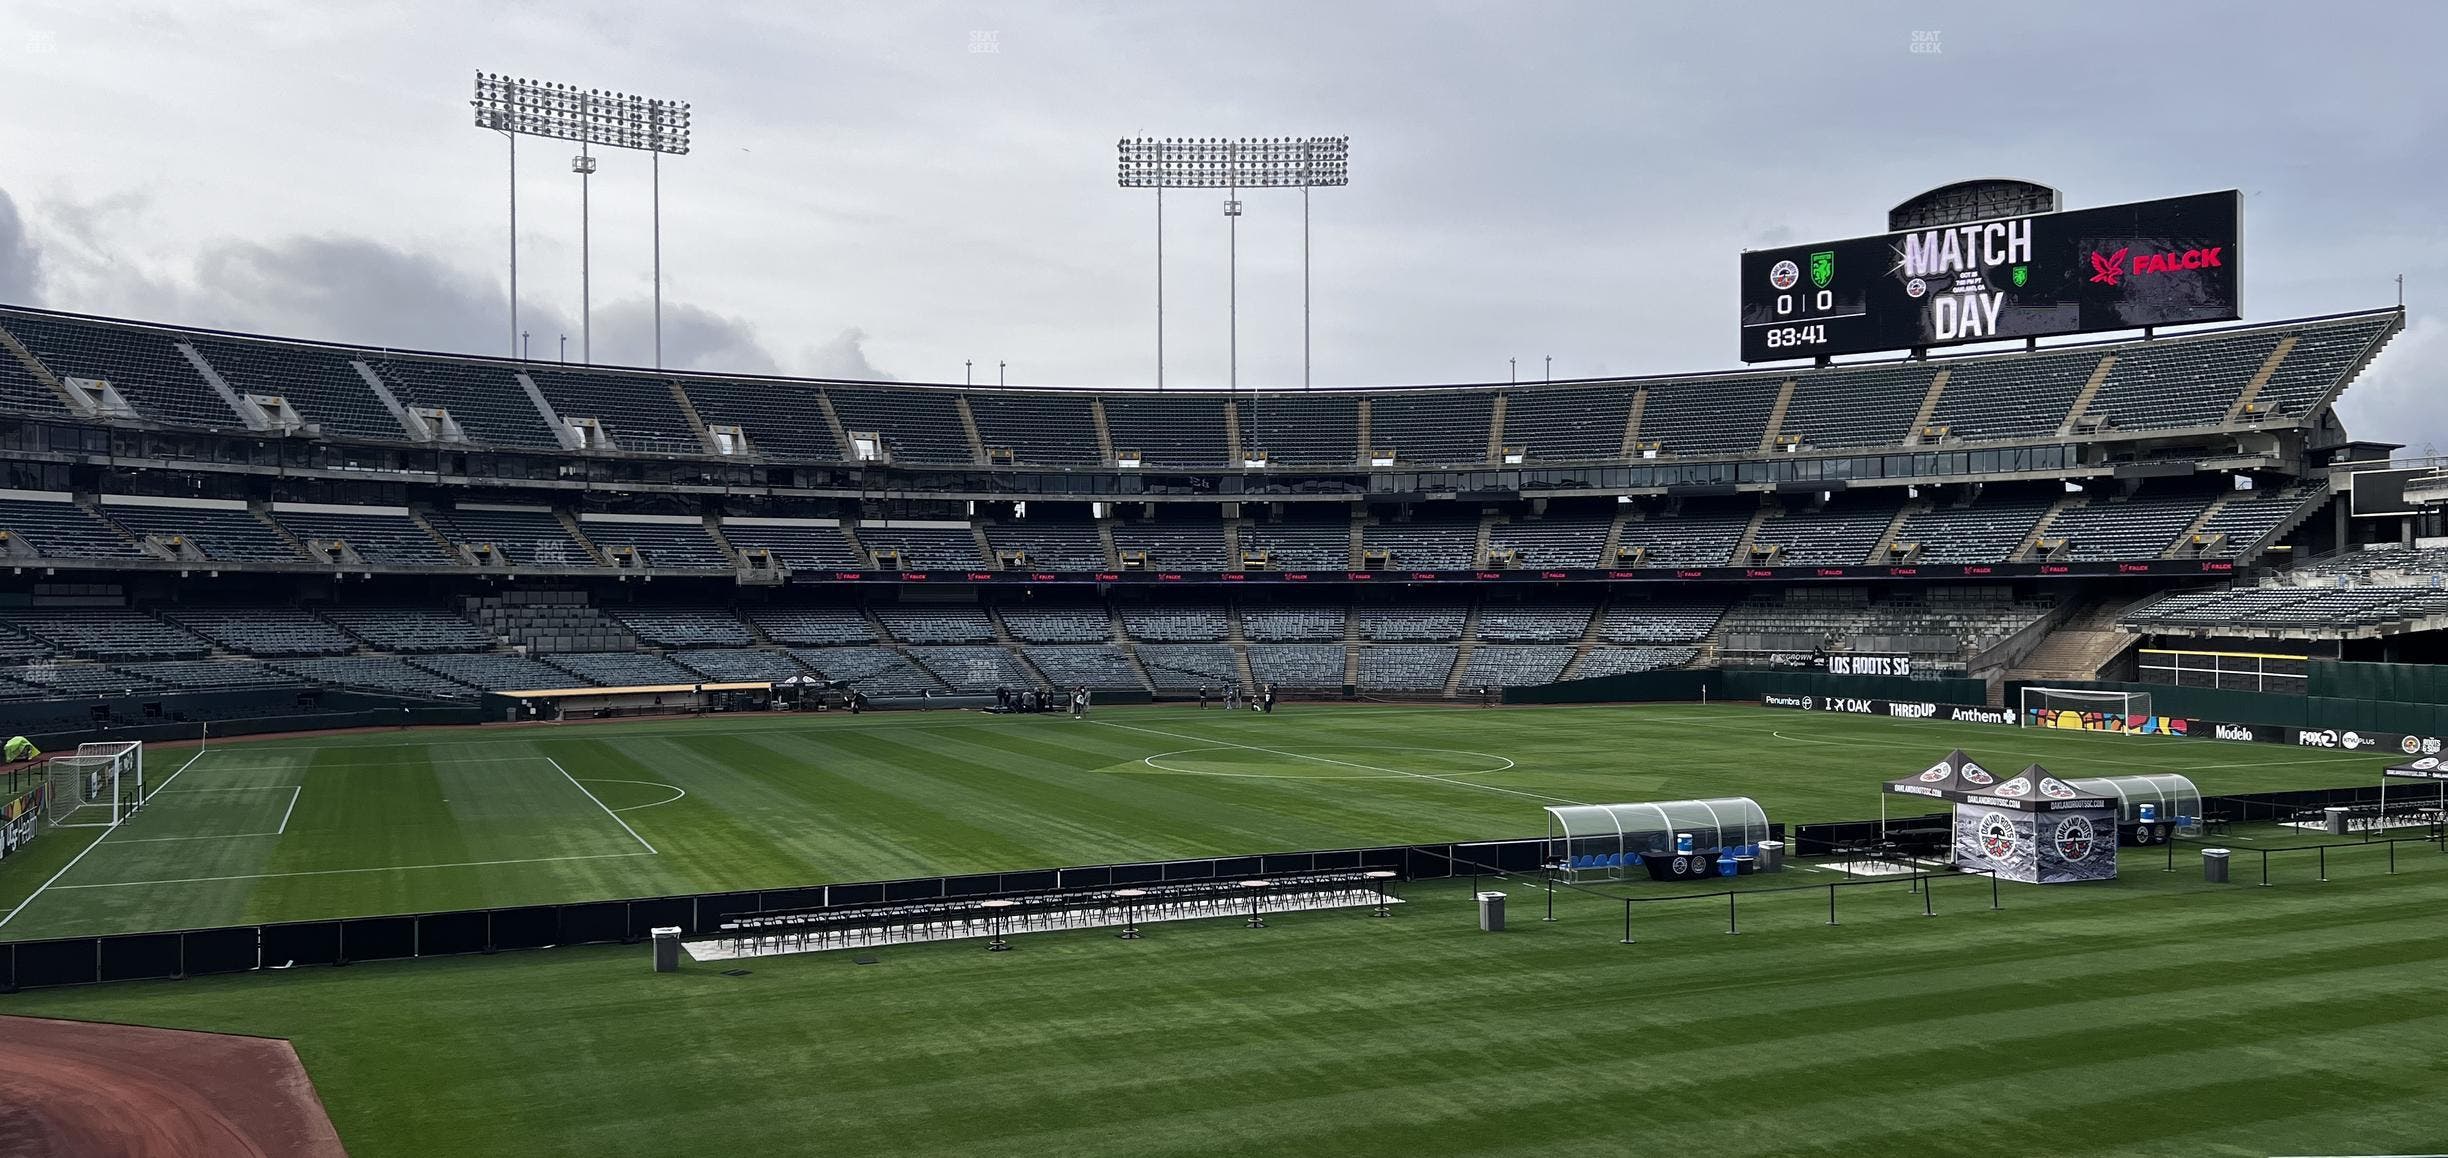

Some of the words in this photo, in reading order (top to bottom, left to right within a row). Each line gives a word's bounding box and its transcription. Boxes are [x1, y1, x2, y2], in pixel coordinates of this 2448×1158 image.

[1905, 219, 2031, 277] MATCH
[2133, 248, 2222, 275] FALCK
[1777, 294, 1793, 315] 0
[1816, 289, 1833, 311] 0
[1935, 291, 2004, 340] DAY
[1767, 324, 1828, 348] 83:41
[1829, 656, 1850, 674] LOS
[1852, 657, 1891, 675] ROOTS
[1766, 695, 1800, 706] Penumbra
[1825, 697, 1832, 711] I
[1847, 699, 1872, 713] OAK
[1888, 703, 1937, 718] THREDUP
[1951, 707, 2002, 724] Anthem
[2215, 724, 2253, 741] Modelo
[2299, 730, 2322, 746] FOX
[1967, 795, 2021, 809] OAKLANDROOTSSC.COM
[2050, 800, 2104, 810] OAKLANDROOTSSC.COM
[2000, 816, 2015, 839] ROOTS
[2079, 819, 2091, 839] ROOTS
